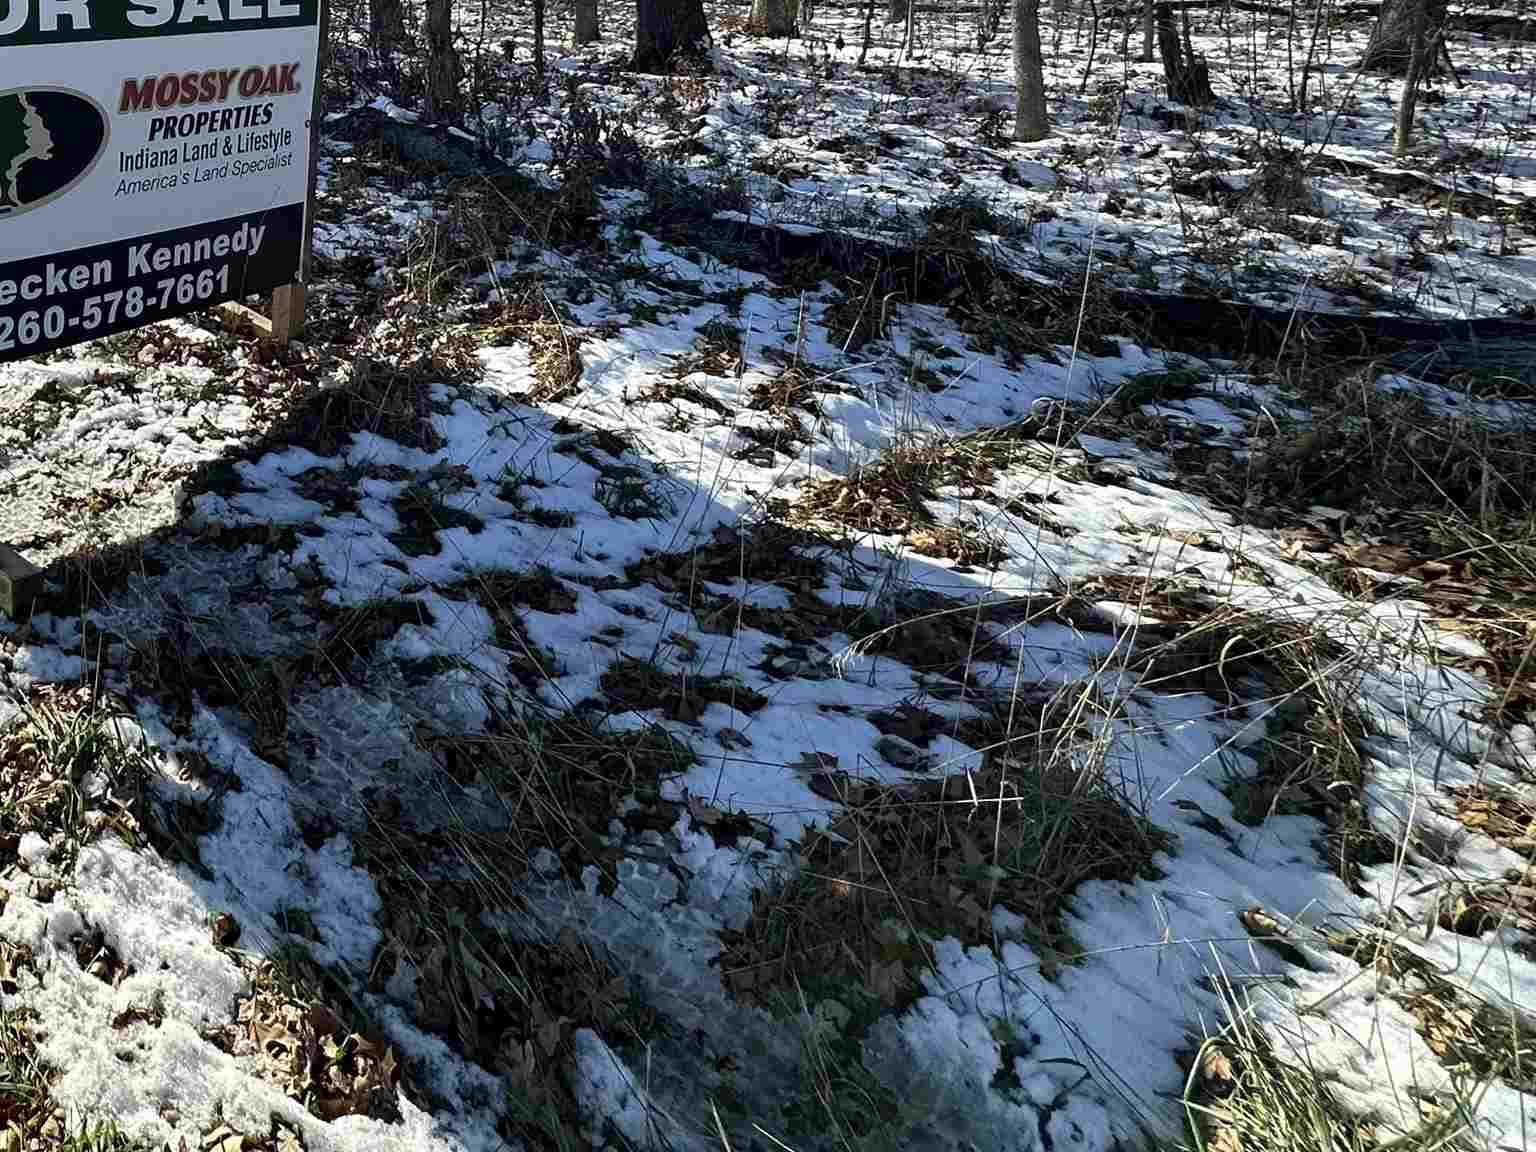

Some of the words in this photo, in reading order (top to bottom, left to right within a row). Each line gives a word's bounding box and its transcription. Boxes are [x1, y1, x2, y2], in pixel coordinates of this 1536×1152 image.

[118, 68, 240, 115] MOSSY
[238, 61, 301, 98] OAK
[148, 103, 274, 142] PROPERTIES
[119, 148, 177, 173] Indiana
[183, 138, 218, 163] Land
[222, 135, 233, 155] &
[237, 127, 292, 154] Lifestyle
[114, 169, 190, 197] America's
[194, 163, 229, 184] Land
[231, 154, 293, 177] Specialist
[127, 222, 266, 277] Kennedy
